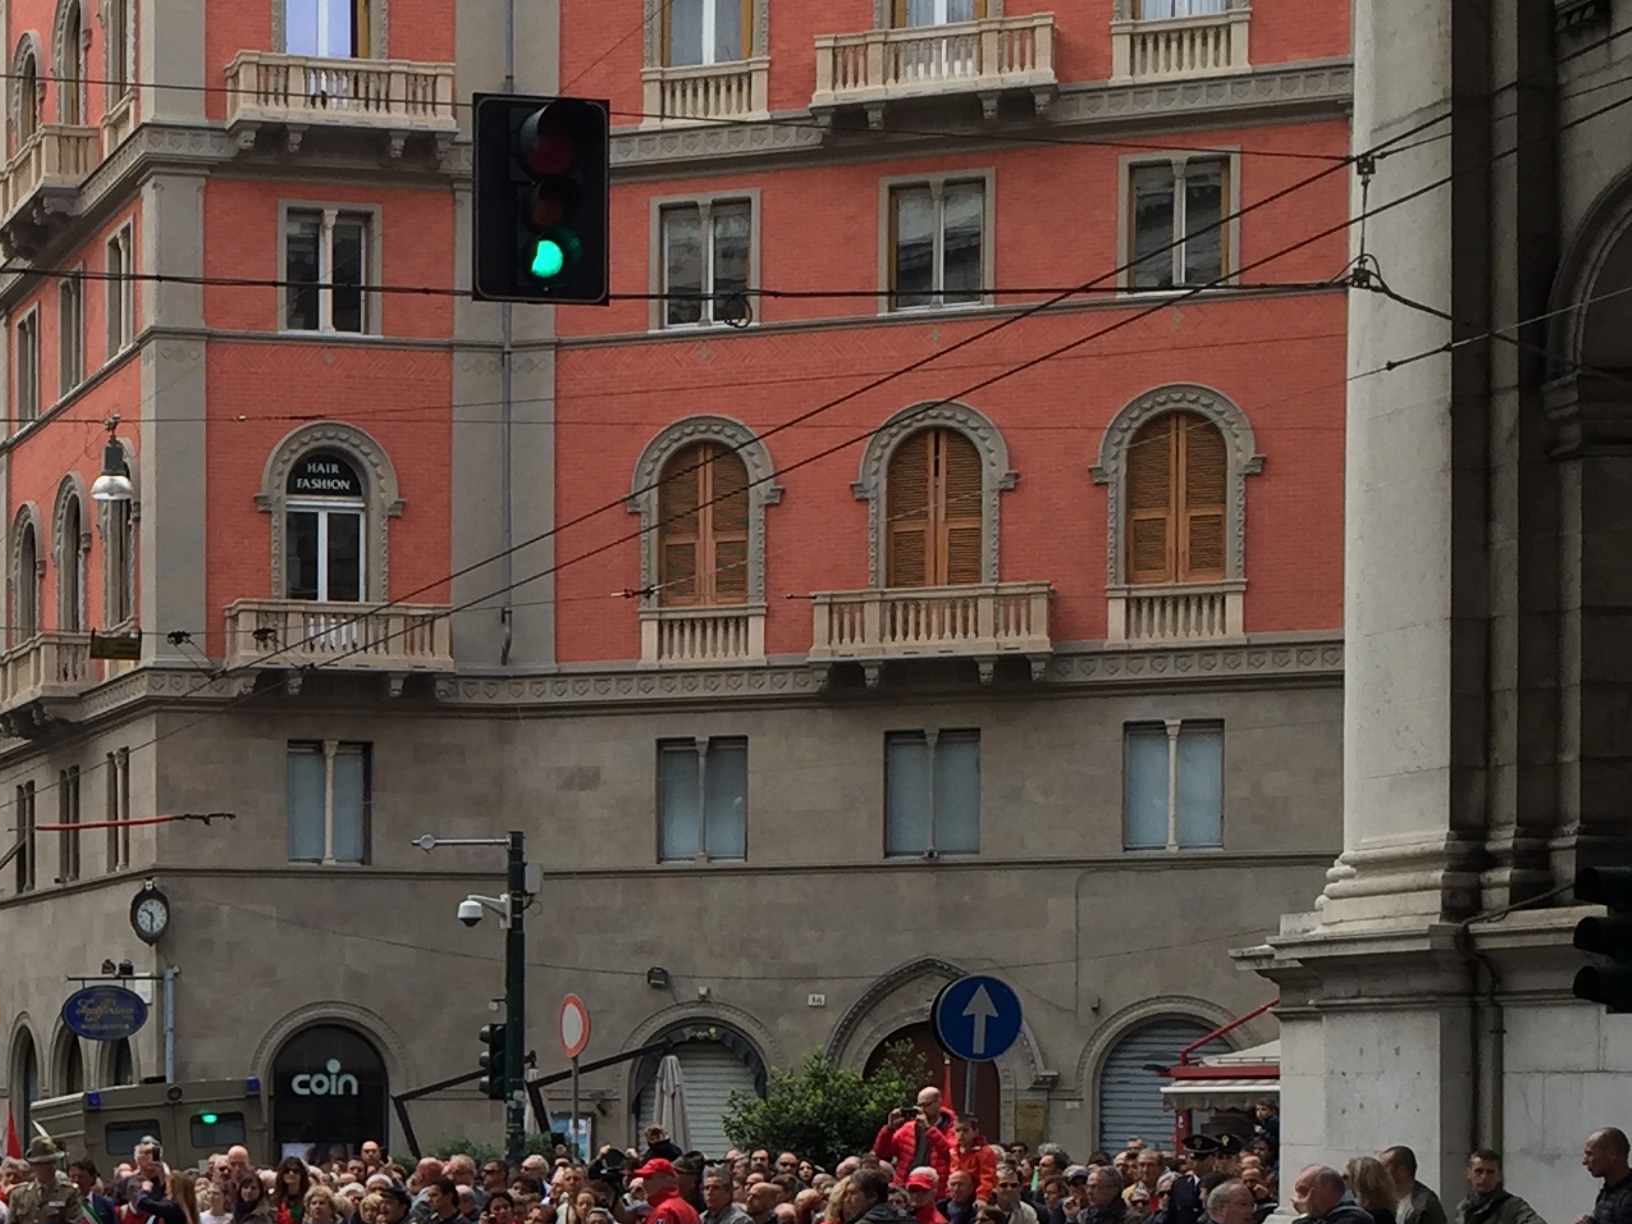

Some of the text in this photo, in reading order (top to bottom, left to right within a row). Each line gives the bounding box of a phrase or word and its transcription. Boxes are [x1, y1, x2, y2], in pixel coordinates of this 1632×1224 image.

[307, 463, 339, 474] HAIR
[296, 478, 350, 490] FASHION
[291, 1058, 358, 1095] coin
